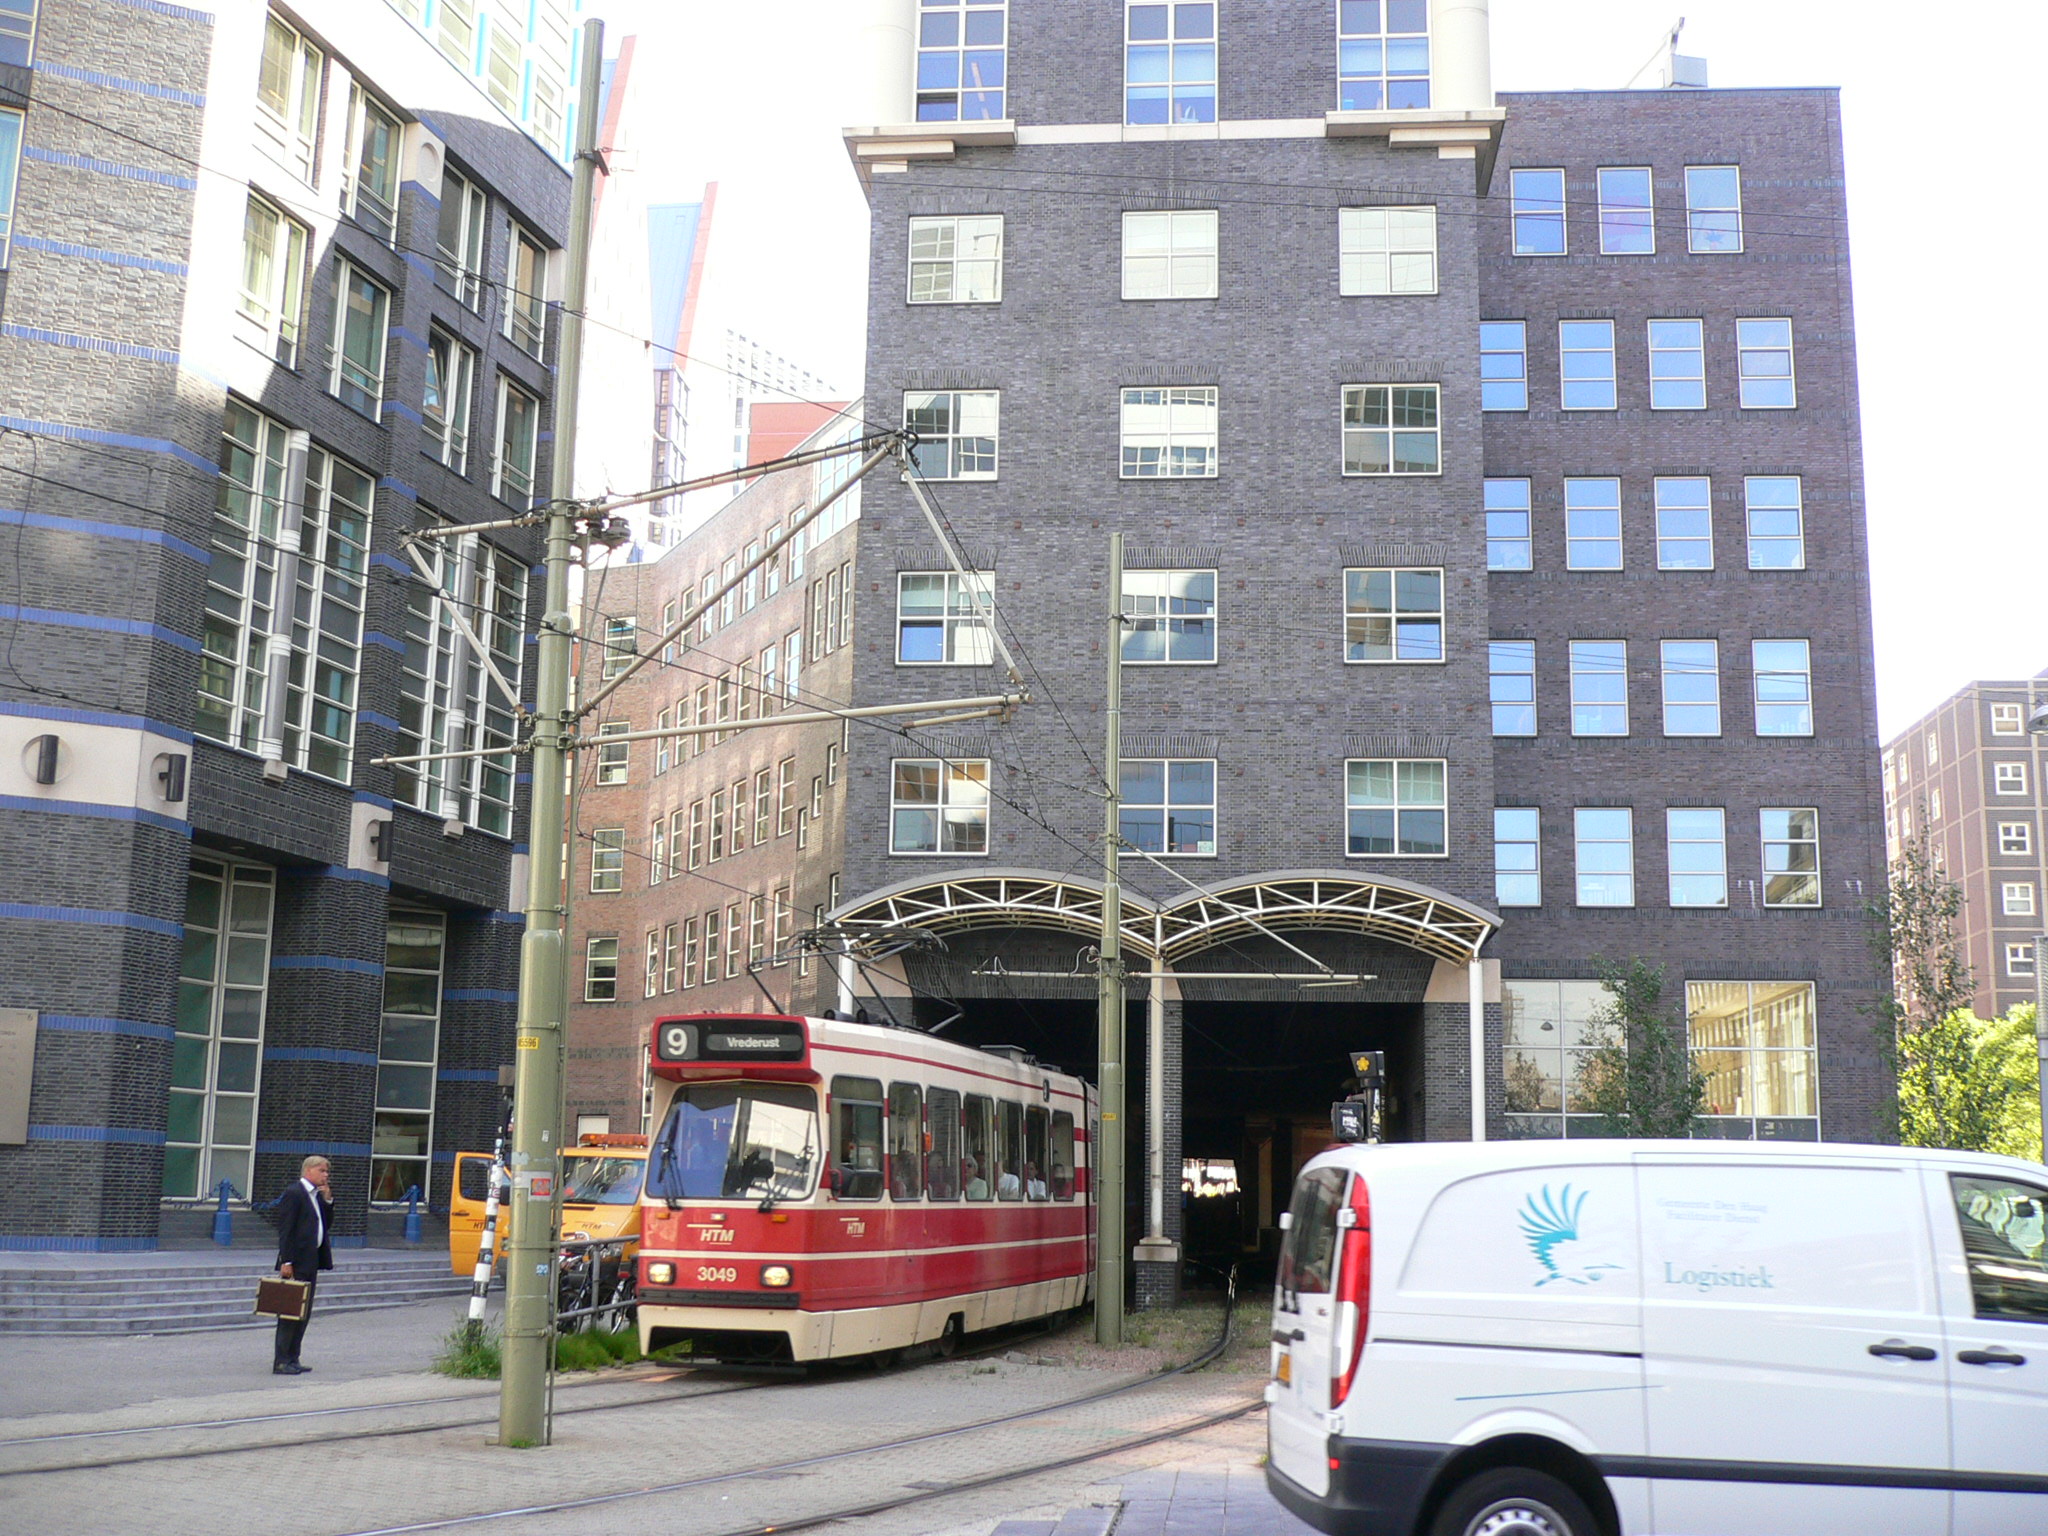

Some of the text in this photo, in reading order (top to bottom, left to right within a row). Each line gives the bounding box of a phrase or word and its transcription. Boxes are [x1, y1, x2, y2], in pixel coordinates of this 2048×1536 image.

[667, 1028, 780, 1055] 9 Vrederust
[700, 1229, 735, 1242] HTM
[847, 1222, 865, 1234] HTM
[697, 1266, 737, 1282] 3049
[1664, 1261, 1775, 1293] Logistiek
